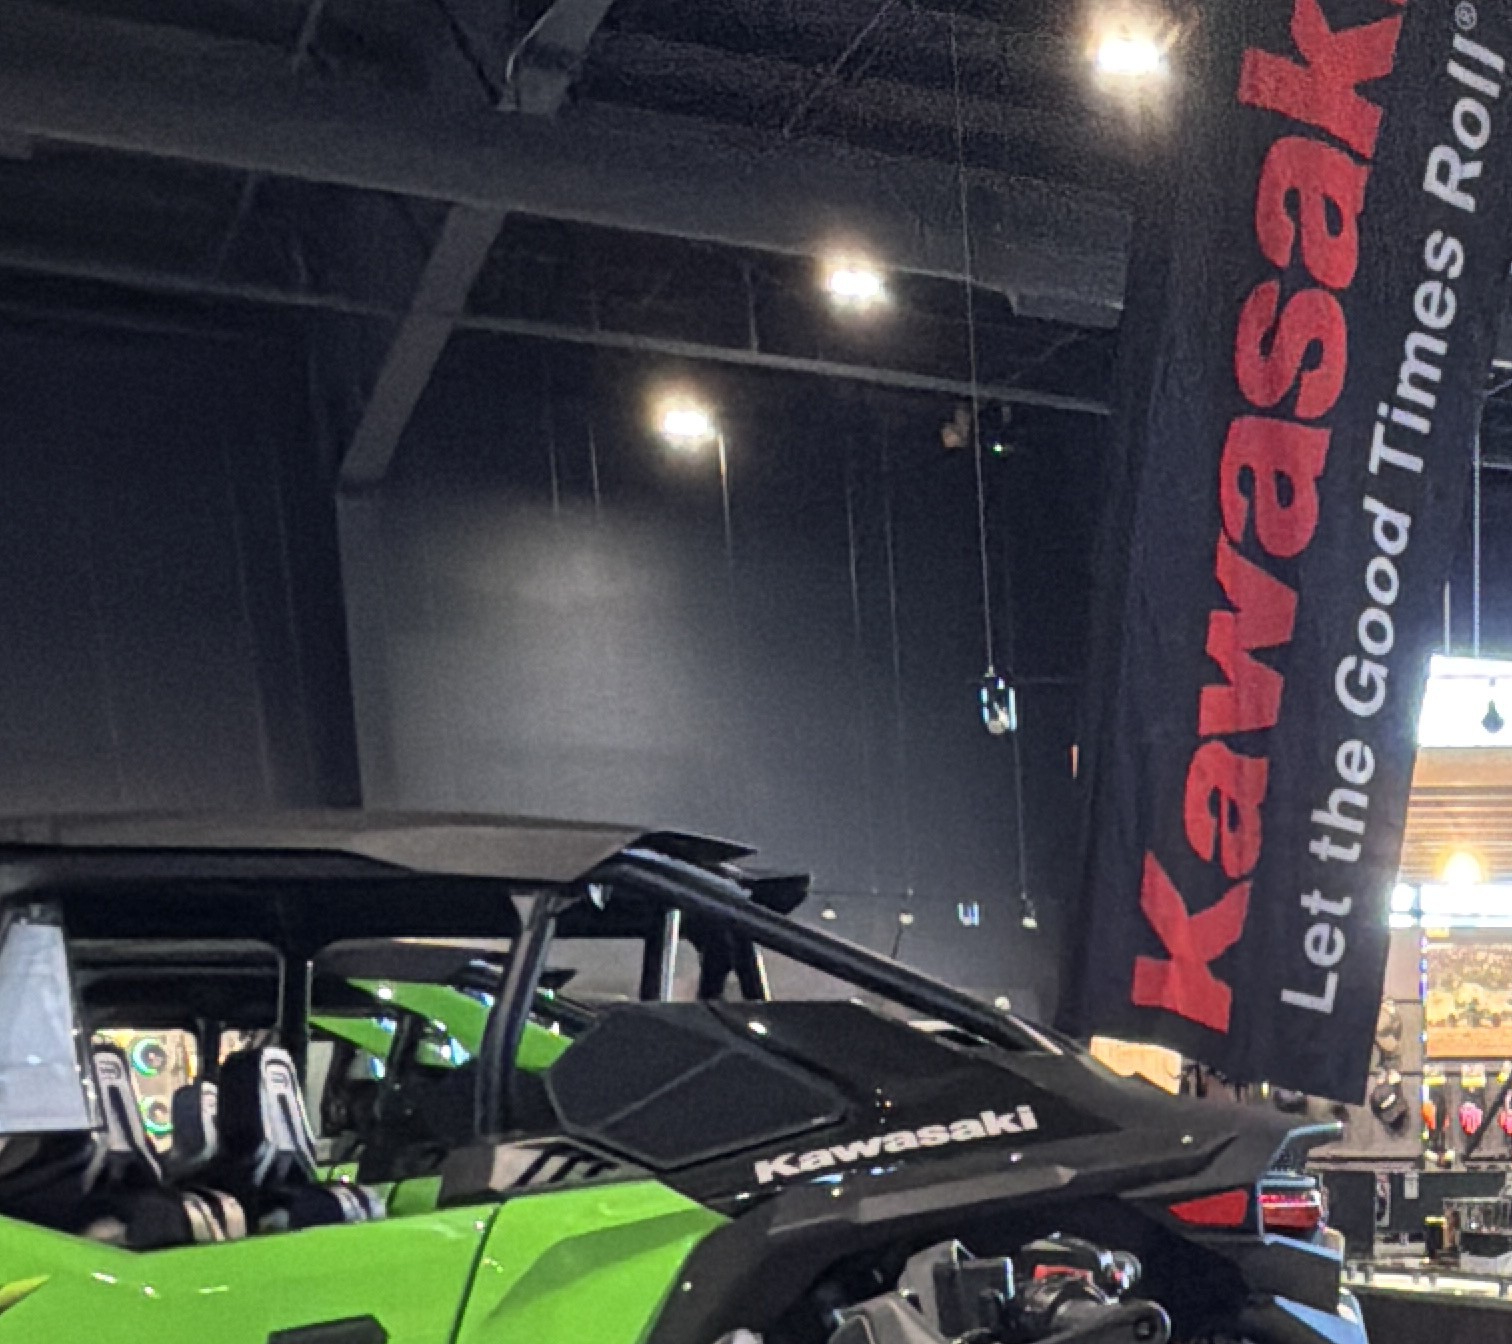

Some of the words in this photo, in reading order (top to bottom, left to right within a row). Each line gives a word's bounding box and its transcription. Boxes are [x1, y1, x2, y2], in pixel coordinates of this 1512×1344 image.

[1369, 230, 1465, 475] Times
[1132, 0, 1404, 1034] Kawasak
[1335, 495, 1412, 717] Good
[1309, 740, 1376, 862] the
[1281, 889, 1352, 1013] Let
[754, 1104, 1038, 1184] Kawasaki
